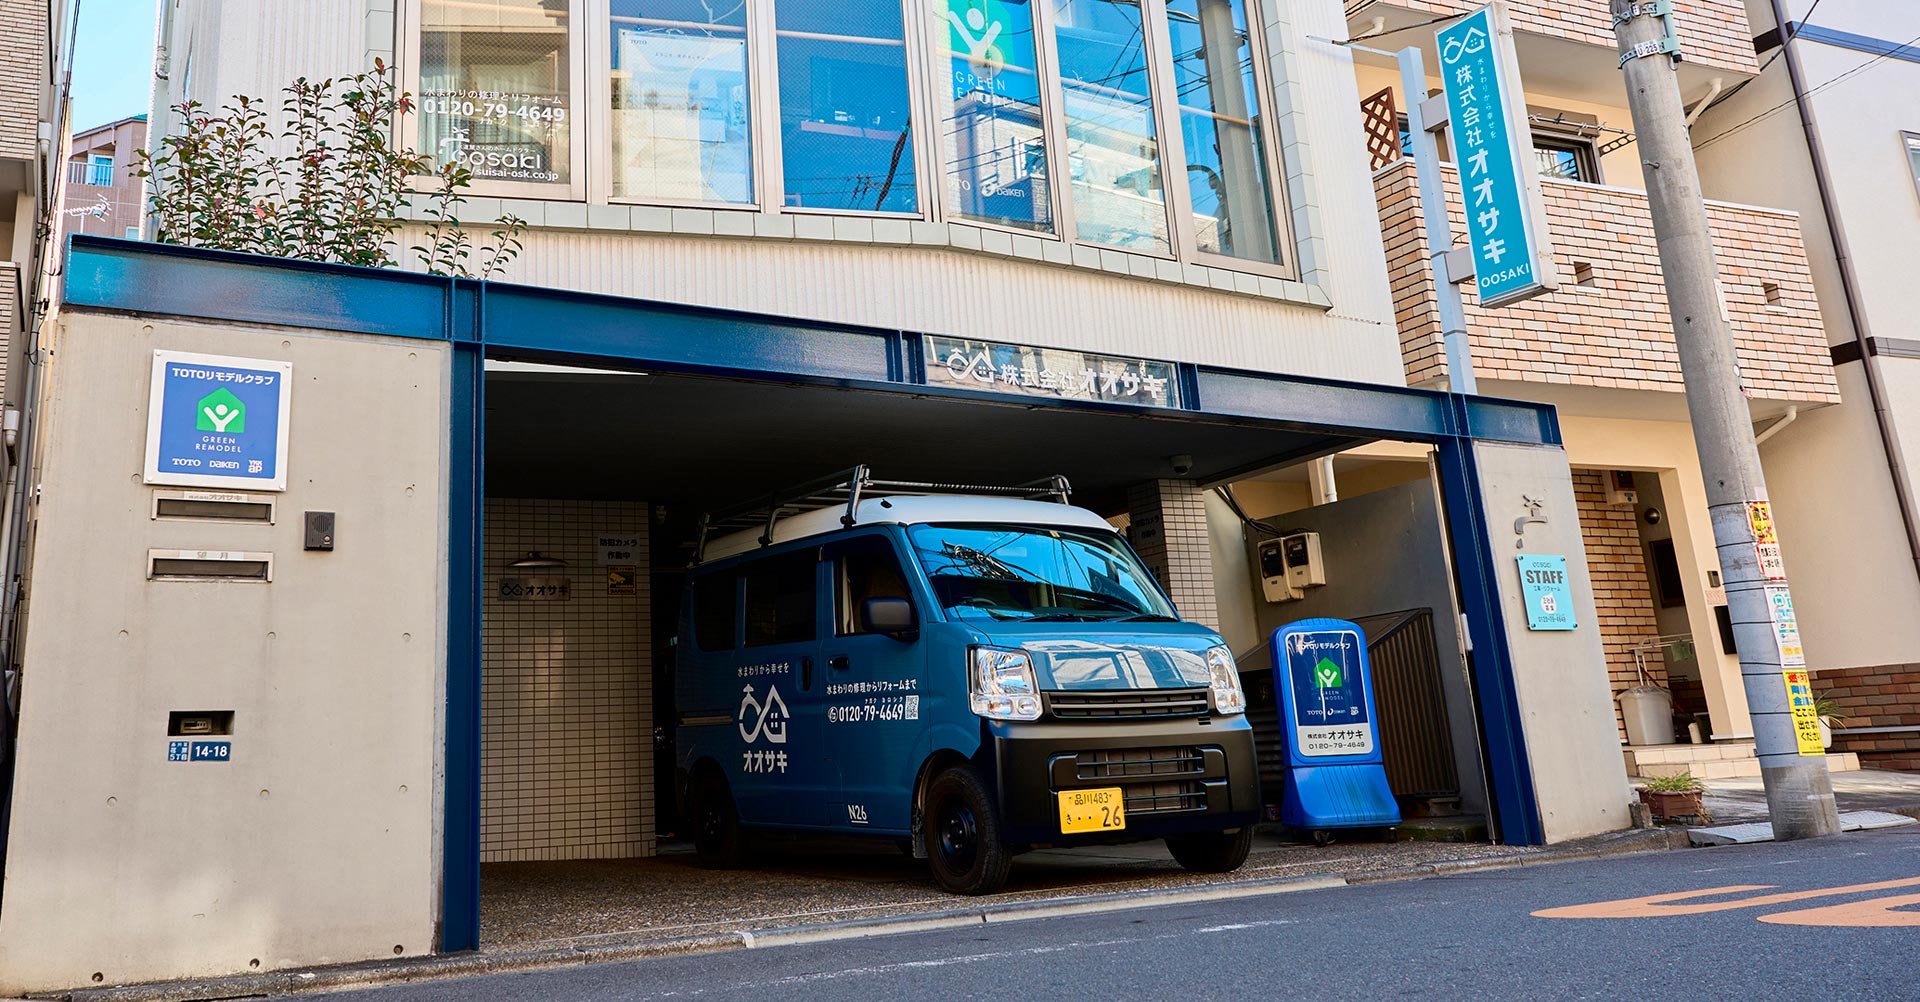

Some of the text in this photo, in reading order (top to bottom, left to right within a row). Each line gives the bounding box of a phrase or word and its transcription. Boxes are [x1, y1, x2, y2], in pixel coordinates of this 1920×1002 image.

[1637, 44, 1658, 56] U-225
[955, 71, 1006, 91] GREEN
[424, 88, 563, 105] 水まわりの修理とリフォーム
[423, 99, 565, 122] 0120-79-4649
[1455, 64, 1507, 265] 株式会社オオサキ
[1481, 263, 1530, 288] OOSAKI
[172, 367, 275, 385] TOTOリモデルクラブ
[1000, 362, 1168, 400] 株式会社オオサキ
[195, 442, 242, 454] REMODEL
[202, 435, 236, 445] GREEN
[172, 457, 202, 468] TOTO
[1525, 569, 1563, 585] STAFF
[525, 585, 569, 597] オオサキ
[737, 662, 790, 677] 水まわりから幸せを
[826, 678, 917, 695] 水まわりの修理からリフォームまで
[838, 703, 904, 722] 0120-79-4649
[195, 745, 228, 757] 14-18
[1308, 741, 1365, 750] 0120-79-4649
[743, 750, 788, 774] オオサキ
[848, 804, 867, 821] N26
